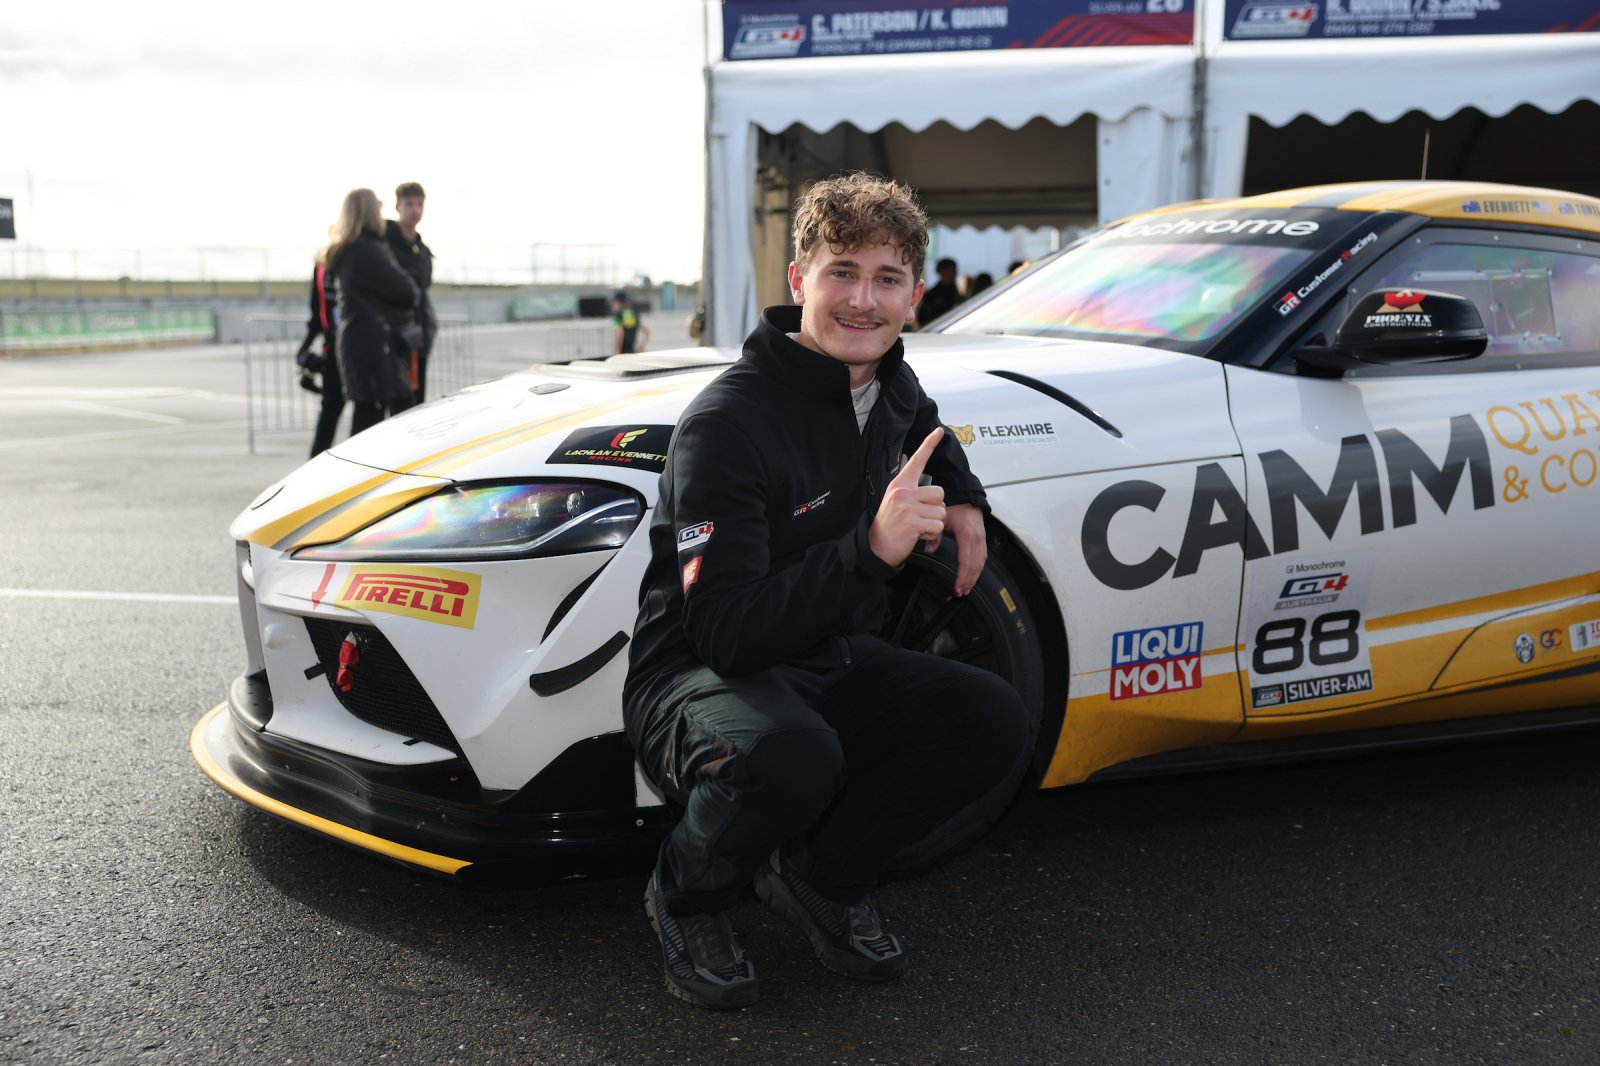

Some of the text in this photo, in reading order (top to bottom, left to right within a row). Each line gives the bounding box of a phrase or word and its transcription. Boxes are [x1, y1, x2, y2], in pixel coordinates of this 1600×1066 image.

[1112, 216, 1320, 240] ochrome
[1279, 231, 1378, 315] GR Customer Racing
[1365, 313, 1432, 324] PHOENIX
[979, 423, 1054, 438] FLEXIHIRE
[1487, 389, 1600, 456] QUA
[588, 455, 633, 463] RACING
[611, 450, 667, 462] EVENNETT
[1503, 465, 1529, 503] &
[1081, 414, 1495, 590] CAMM
[679, 522, 714, 543] GT4
[1296, 561, 1346, 573] Monochrome
[343, 573, 469, 617] PIRELLI
[1279, 573, 1349, 599] GT4
[1116, 624, 1200, 664] LIQUI
[1252, 609, 1360, 675] 88
[1114, 657, 1200, 697] MOLY
[1288, 672, 1370, 700] SILVER-AM
